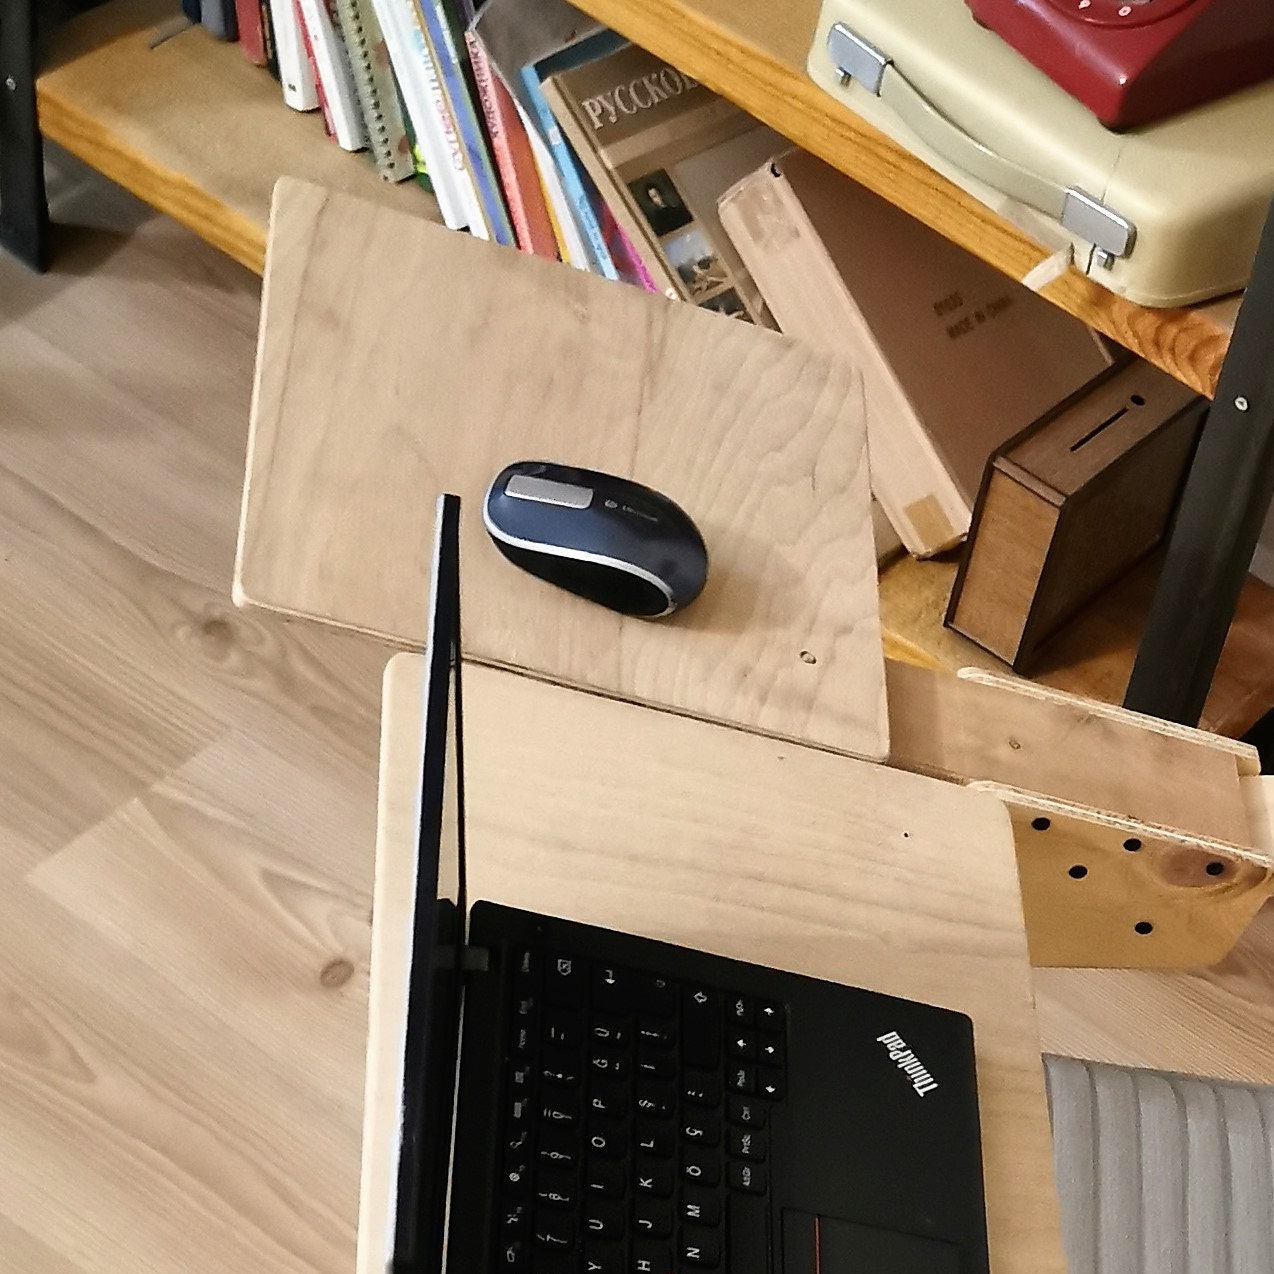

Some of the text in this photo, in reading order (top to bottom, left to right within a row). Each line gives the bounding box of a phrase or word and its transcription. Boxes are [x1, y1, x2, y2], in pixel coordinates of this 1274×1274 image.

[876, 1031, 939, 1097] ThinkPad
[592, 1099, 606, 1108] P
[685, 1126, 704, 1136] Ç
[591, 1136, 605, 1147] O
[639, 1139, 654, 1148] L
[685, 1165, 701, 1176] Ö
[638, 1177, 653, 1188] K
[687, 1205, 700, 1218] M
[588, 1219, 603, 1230] U
[638, 1219, 653, 1230] J
[686, 1246, 701, 1260] N
[588, 1260, 602, 1270] Y
[636, 1260, 650, 1271] H
